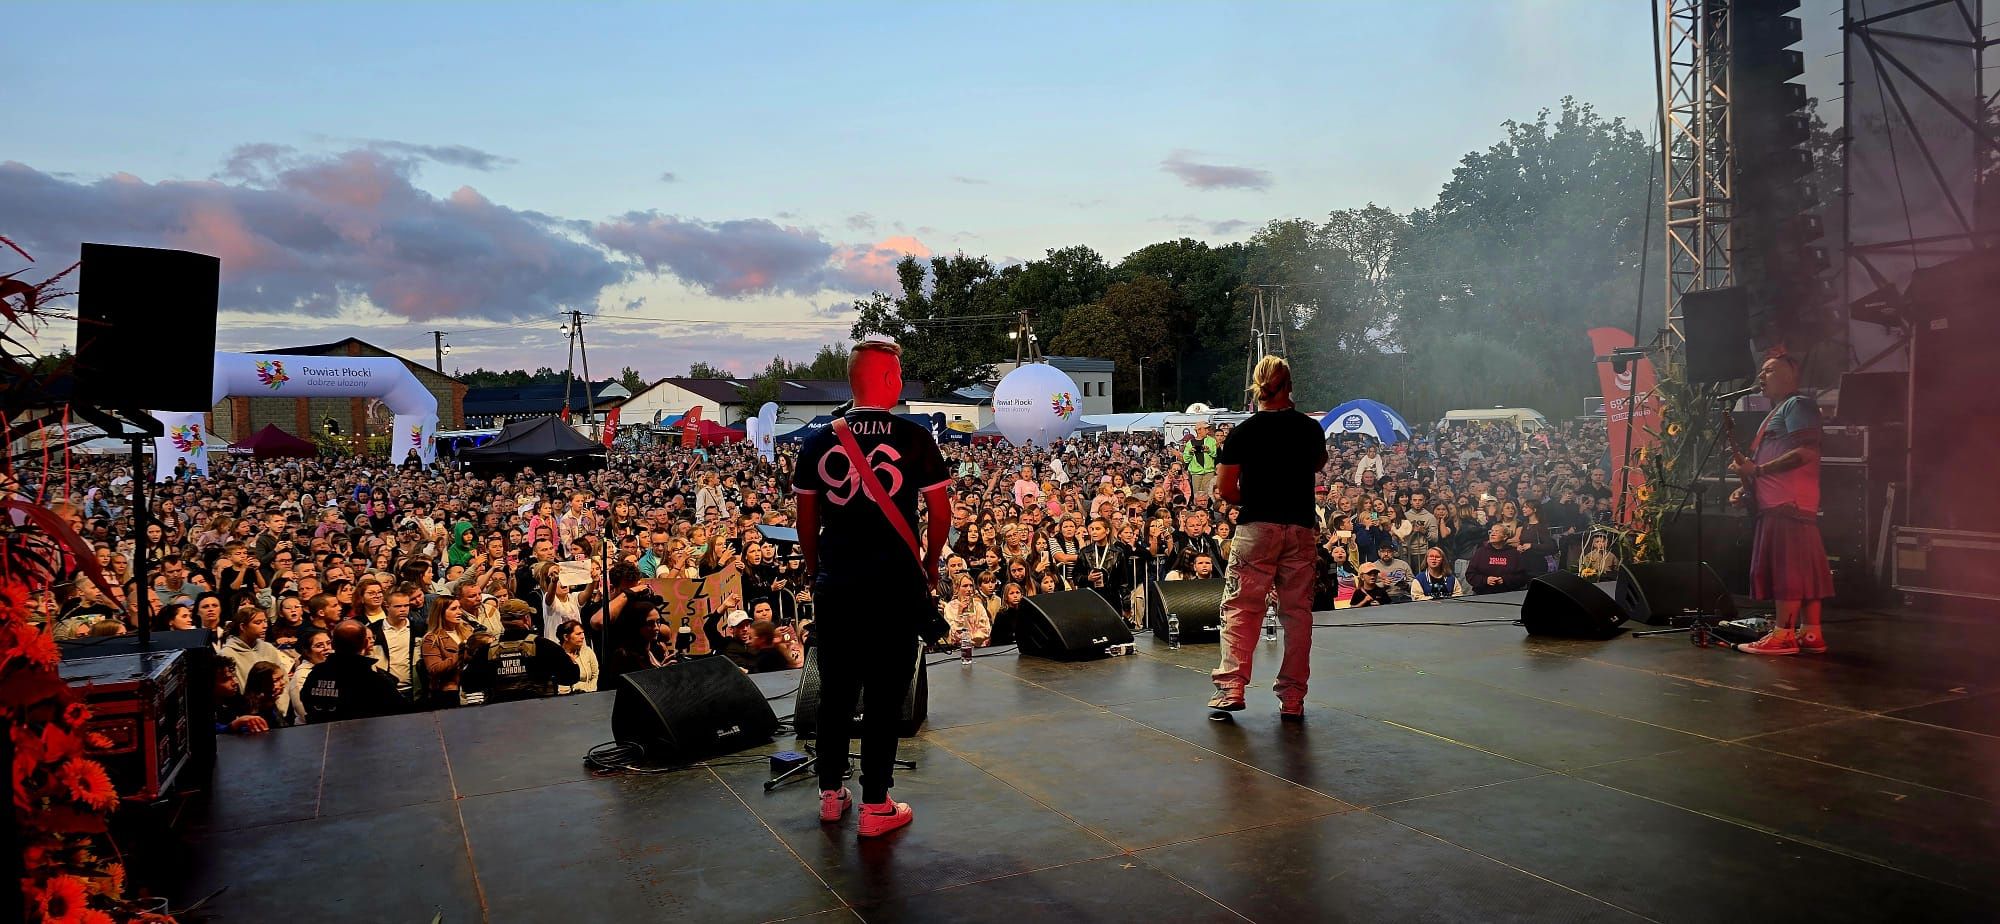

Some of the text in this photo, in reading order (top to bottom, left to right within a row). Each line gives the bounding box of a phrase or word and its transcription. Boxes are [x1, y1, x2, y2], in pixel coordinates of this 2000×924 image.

[302, 366, 372, 377] Powiat Płocki
[307, 378, 336, 386] dobrze
[831, 421, 892, 436] OLIM
[817, 443, 904, 506] 96
[502, 659, 521, 667] VIPER
[497, 665, 527, 675] OCHRONA
[317, 680, 336, 688] VIPER
